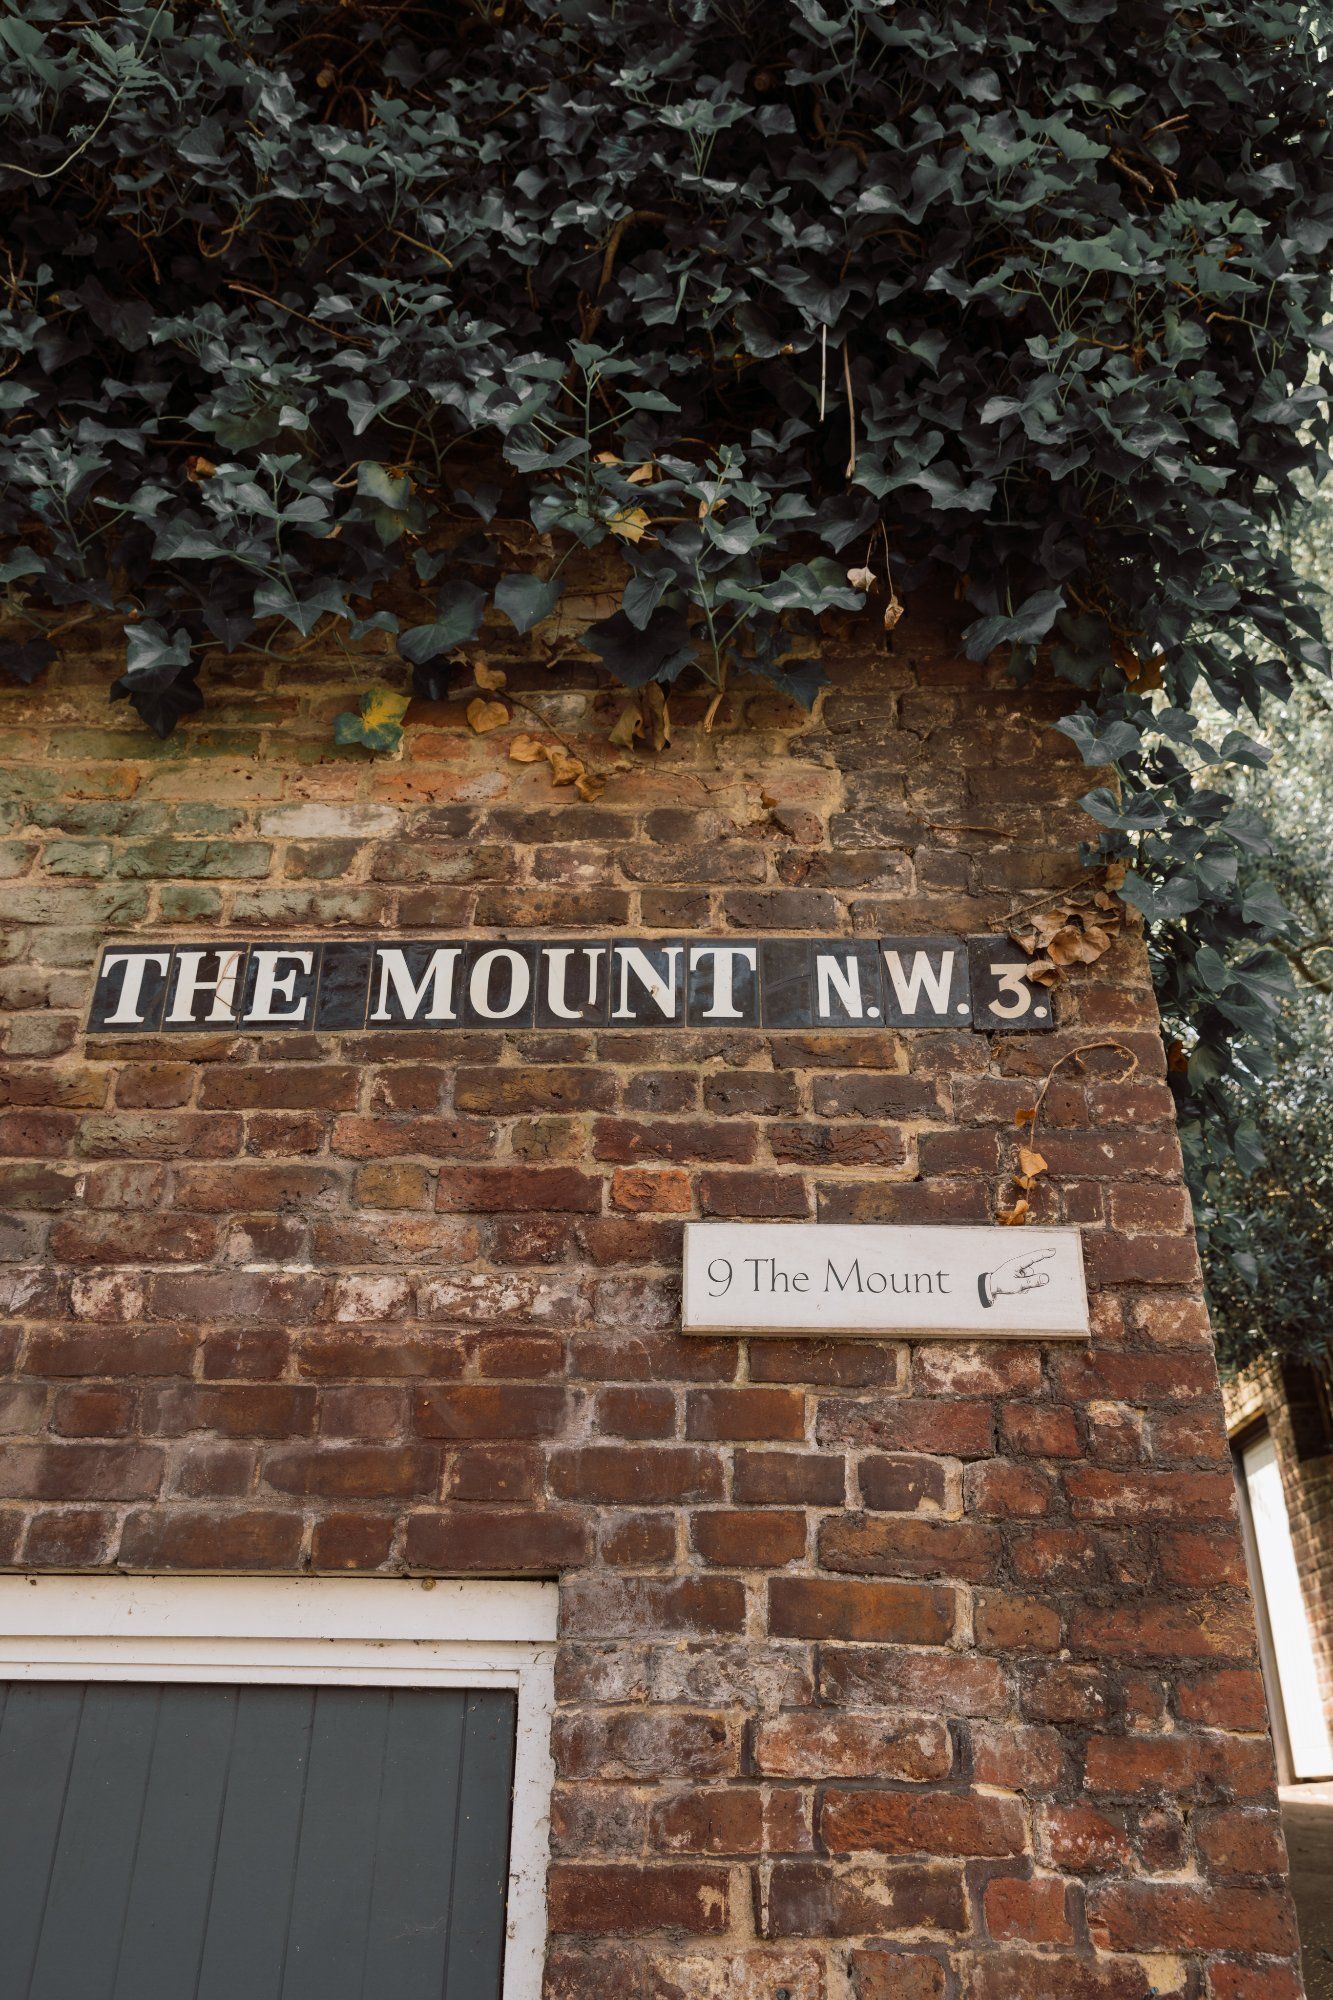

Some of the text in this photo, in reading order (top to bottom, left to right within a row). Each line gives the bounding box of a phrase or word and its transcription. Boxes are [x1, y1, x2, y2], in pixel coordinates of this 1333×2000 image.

[101, 949, 314, 1024] THE
[370, 946, 757, 1021] MOUNT
[707, 1257, 952, 1297] 9 The Mount
